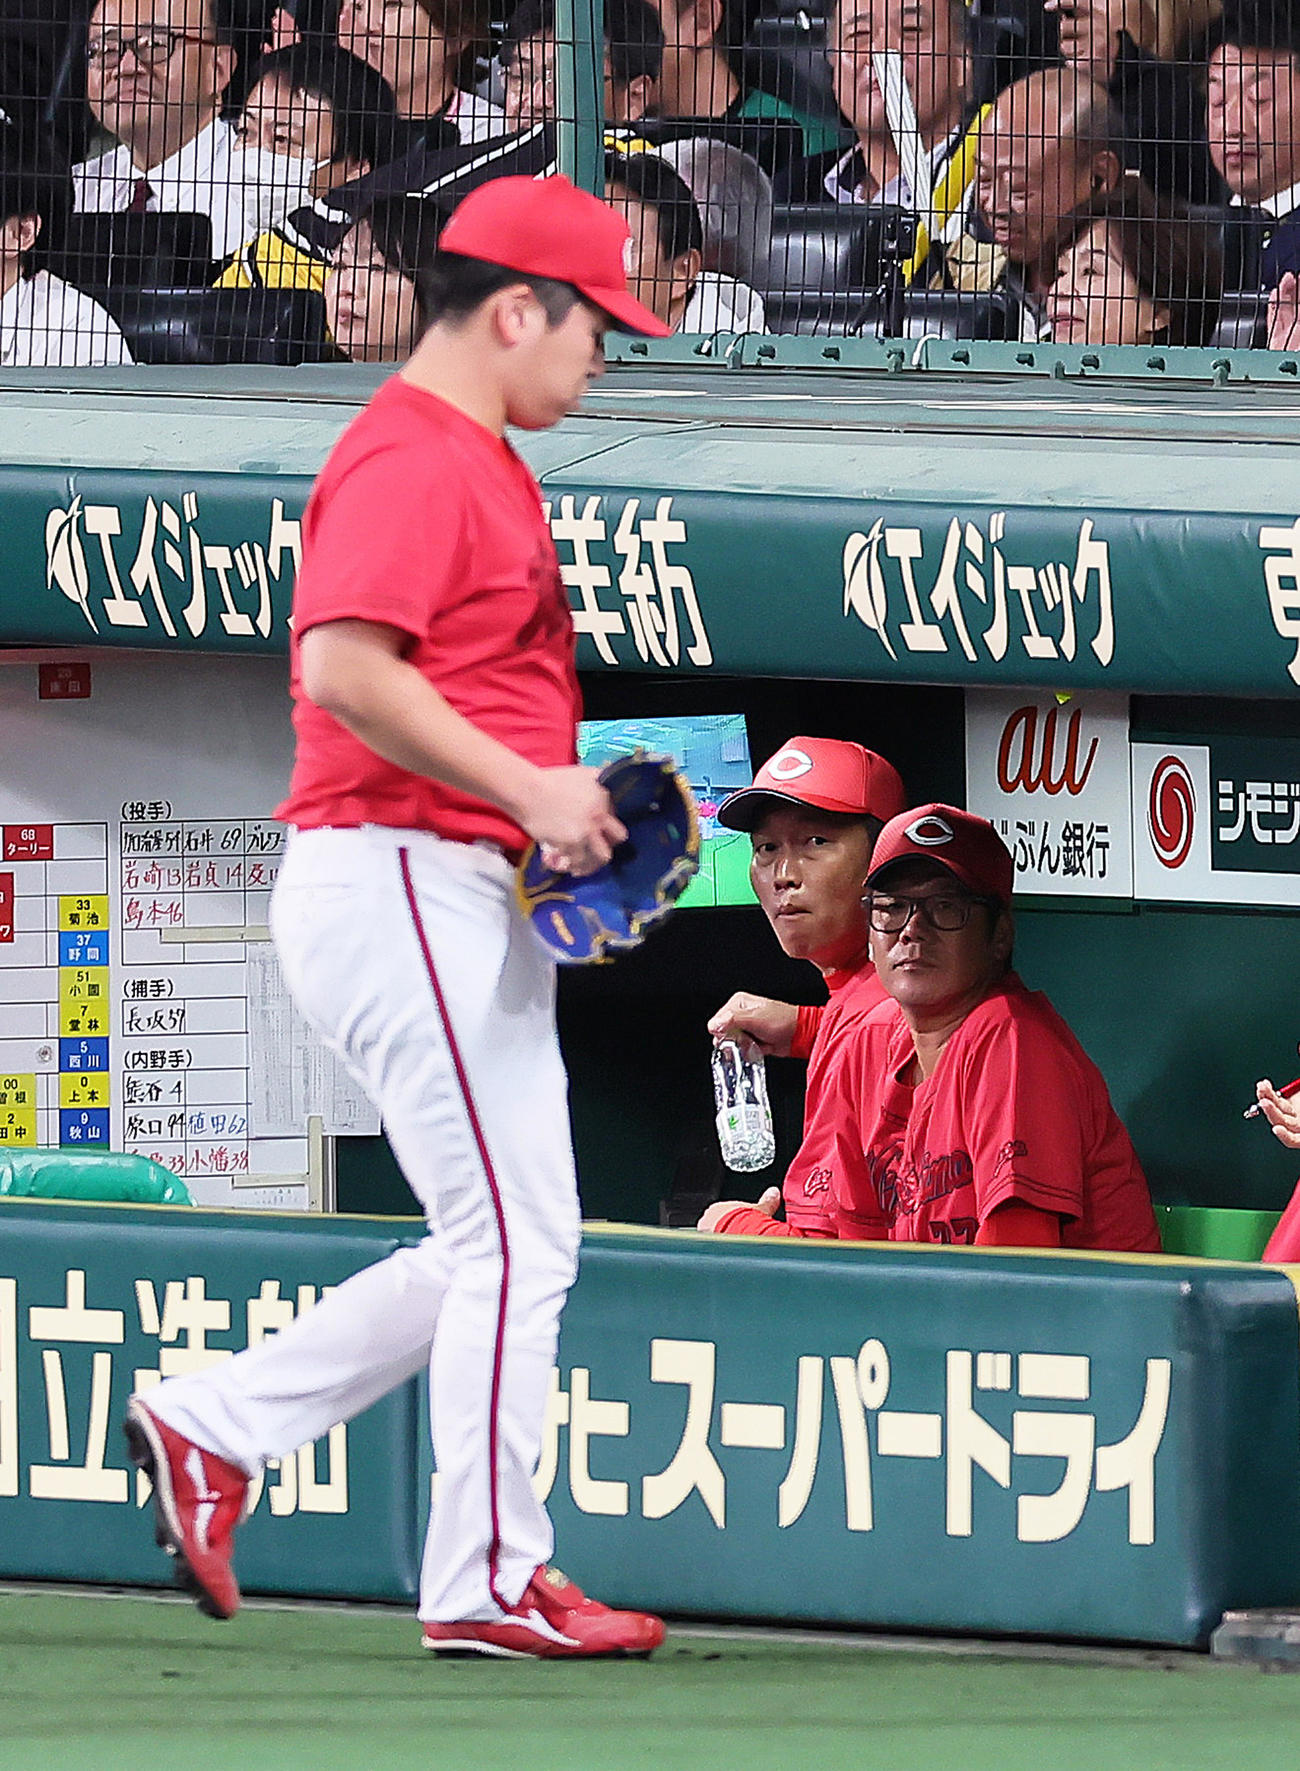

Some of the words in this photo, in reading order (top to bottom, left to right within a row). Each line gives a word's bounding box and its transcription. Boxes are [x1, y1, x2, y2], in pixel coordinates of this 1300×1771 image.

[884, 511, 1116, 668] エイジェック
[996, 705, 1099, 797] au
[121, 801, 172, 820] (投手)
[21, 829, 35, 841] 68
[76, 899, 91, 911] 33
[76, 934, 91, 946] 37
[77, 970, 90, 982] 51
[123, 979, 174, 999] (捕手)
[80, 1005, 89, 1017] 7
[124, 1050, 193, 1069] (内野手)
[3, 1078, 18, 1090] 00
[80, 1076, 88, 1087] 0
[68, 1089, 99, 1102] 上本
[7, 1112, 15, 1124] 2
[80, 1112, 89, 1124] 9
